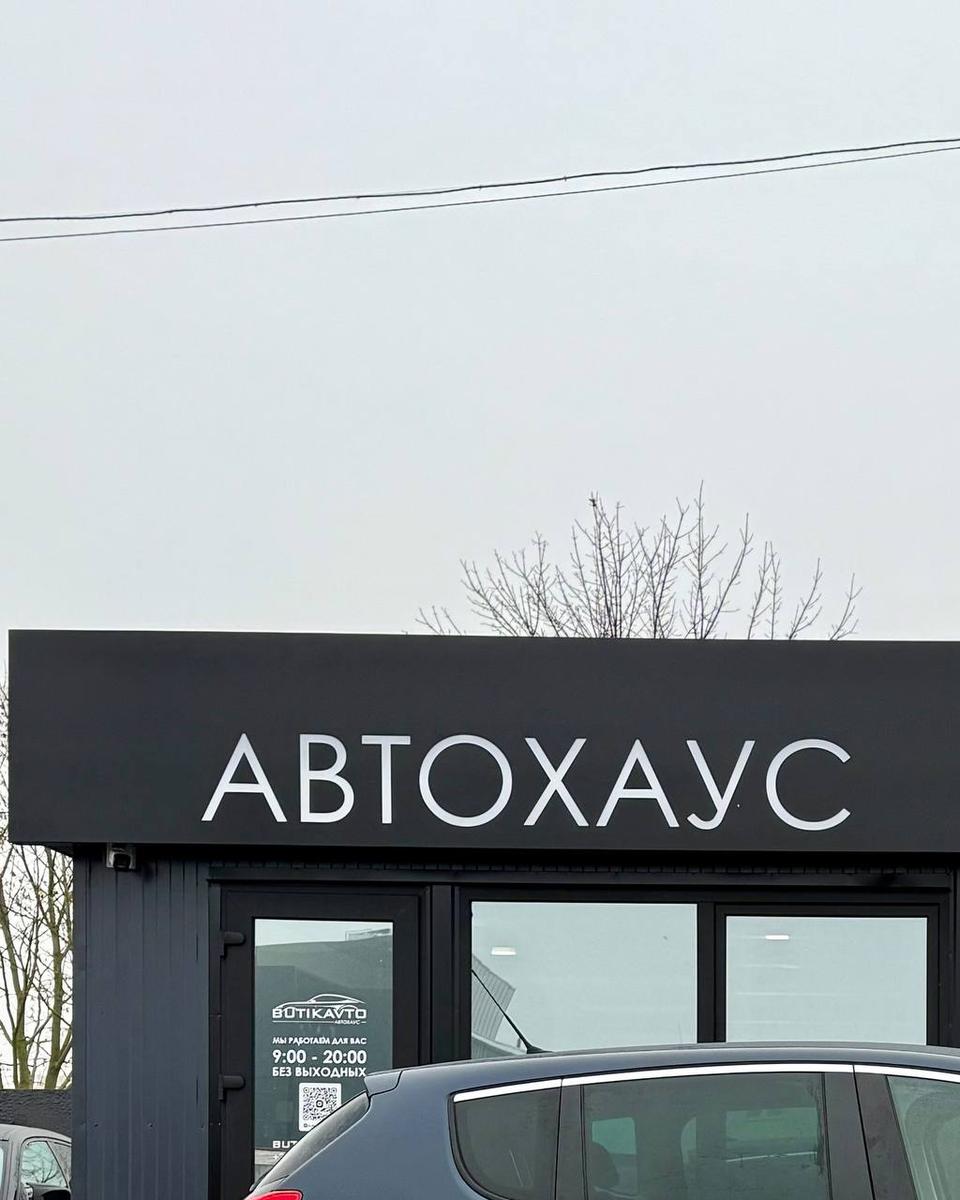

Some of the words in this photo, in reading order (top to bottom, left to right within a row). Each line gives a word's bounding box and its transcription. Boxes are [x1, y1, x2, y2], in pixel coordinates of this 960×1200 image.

[202, 733, 852, 831] АВТОХАУС
[272, 1008, 367, 1019] BUTIKAVTO
[272, 1037, 287, 1045] МЫ
[288, 1037, 331, 1046] РАБОТАЕМ
[272, 1049, 307, 1064] 9:00
[322, 1049, 367, 1064] 20:00
[272, 1066, 292, 1077] БЕЗ
[295, 1066, 367, 1078] ВЫХОДНЫХ
